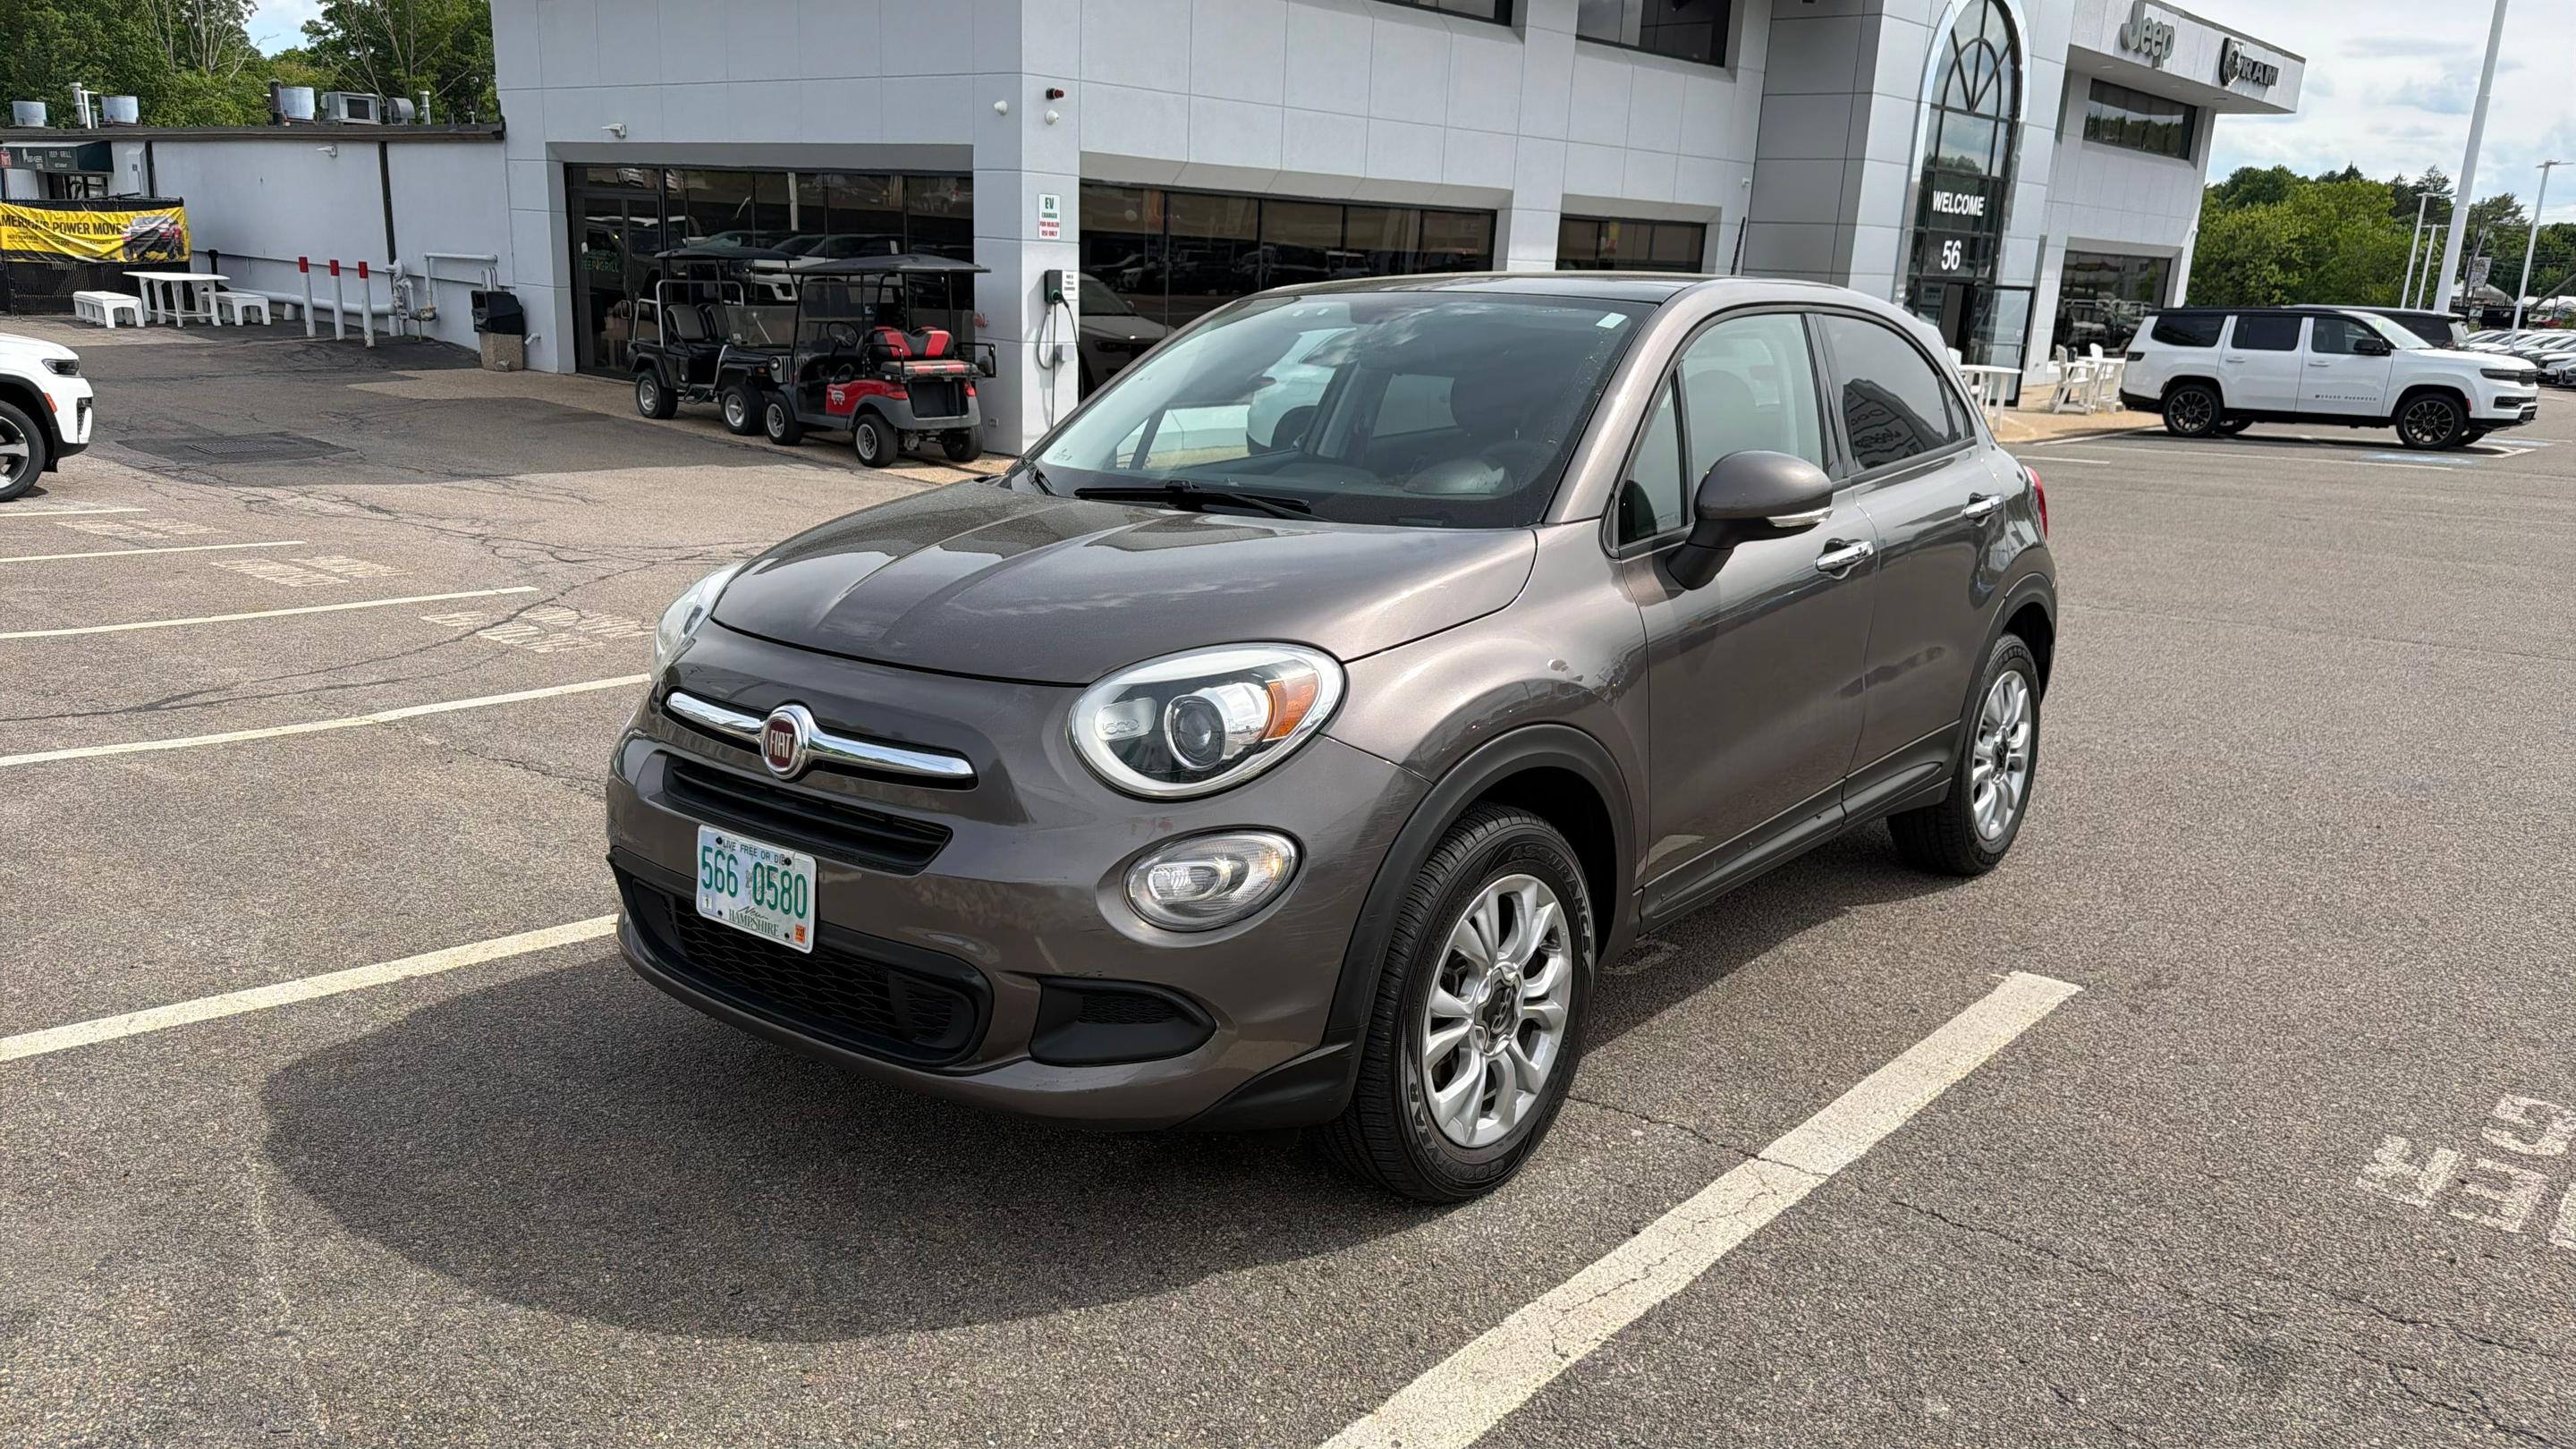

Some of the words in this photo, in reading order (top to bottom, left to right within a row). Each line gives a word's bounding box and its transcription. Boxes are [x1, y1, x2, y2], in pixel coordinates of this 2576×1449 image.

[2121, 0, 2174, 68] Jeep
[2240, 56, 2279, 86] RAM
[1045, 197, 1054, 209] EV
[1933, 190, 1985, 216] WELCOME
[52, 222, 90, 233] POWER
[1941, 240, 1962, 271] 56
[769, 729, 793, 759] FIAT
[723, 839, 735, 852] LIVE
[740, 844, 758, 859] FREE
[760, 850, 770, 860] OR
[701, 845, 739, 898] 566
[752, 861, 808, 919] 0580
[729, 908, 779, 937] HAMPSHIRE
